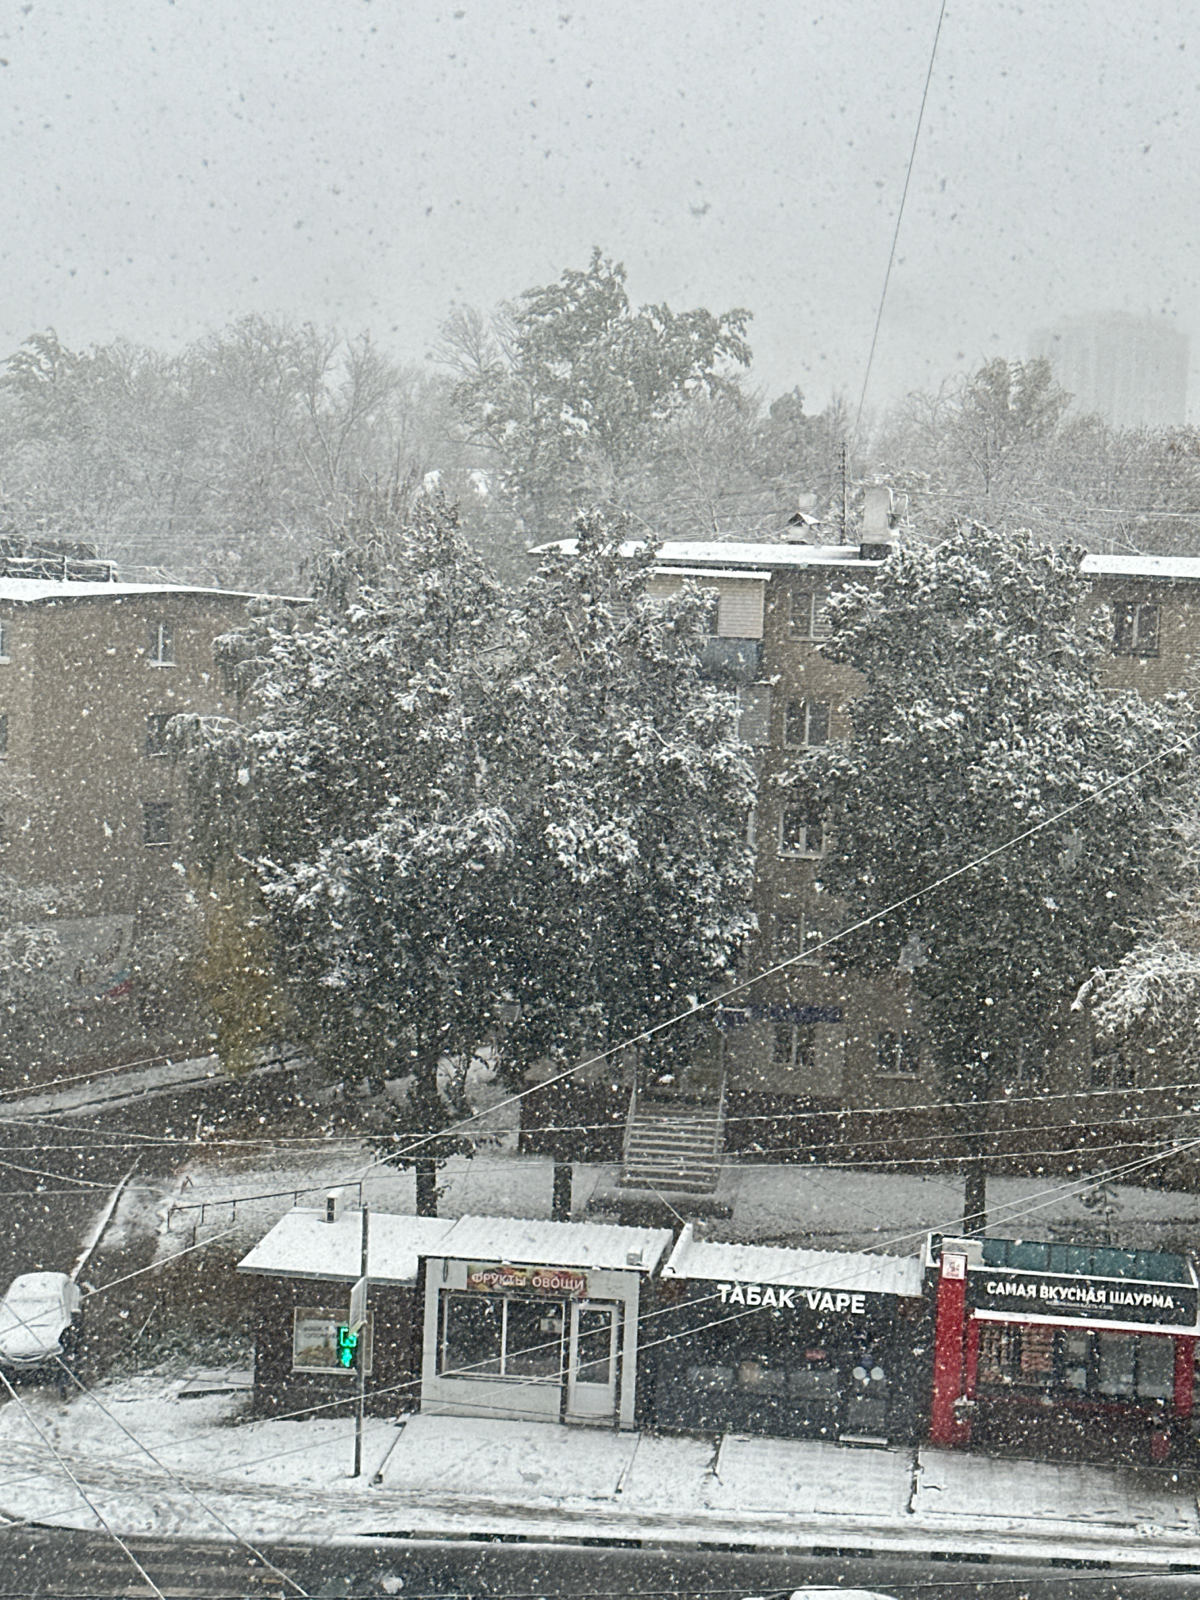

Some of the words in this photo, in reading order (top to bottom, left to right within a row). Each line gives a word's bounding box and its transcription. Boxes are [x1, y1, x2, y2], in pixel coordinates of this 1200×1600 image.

[471, 1271, 526, 1287] ФРУКТЫ
[532, 1276, 584, 1291] ОВОЩИ
[986, 1281, 1037, 1298] САМАЯ
[1039, 1284, 1106, 1304] ВКУСНАЯ
[1109, 1290, 1174, 1309] ШАУРМА
[716, 1283, 795, 1309] ТАБАК
[806, 1290, 866, 1314] VAPE
